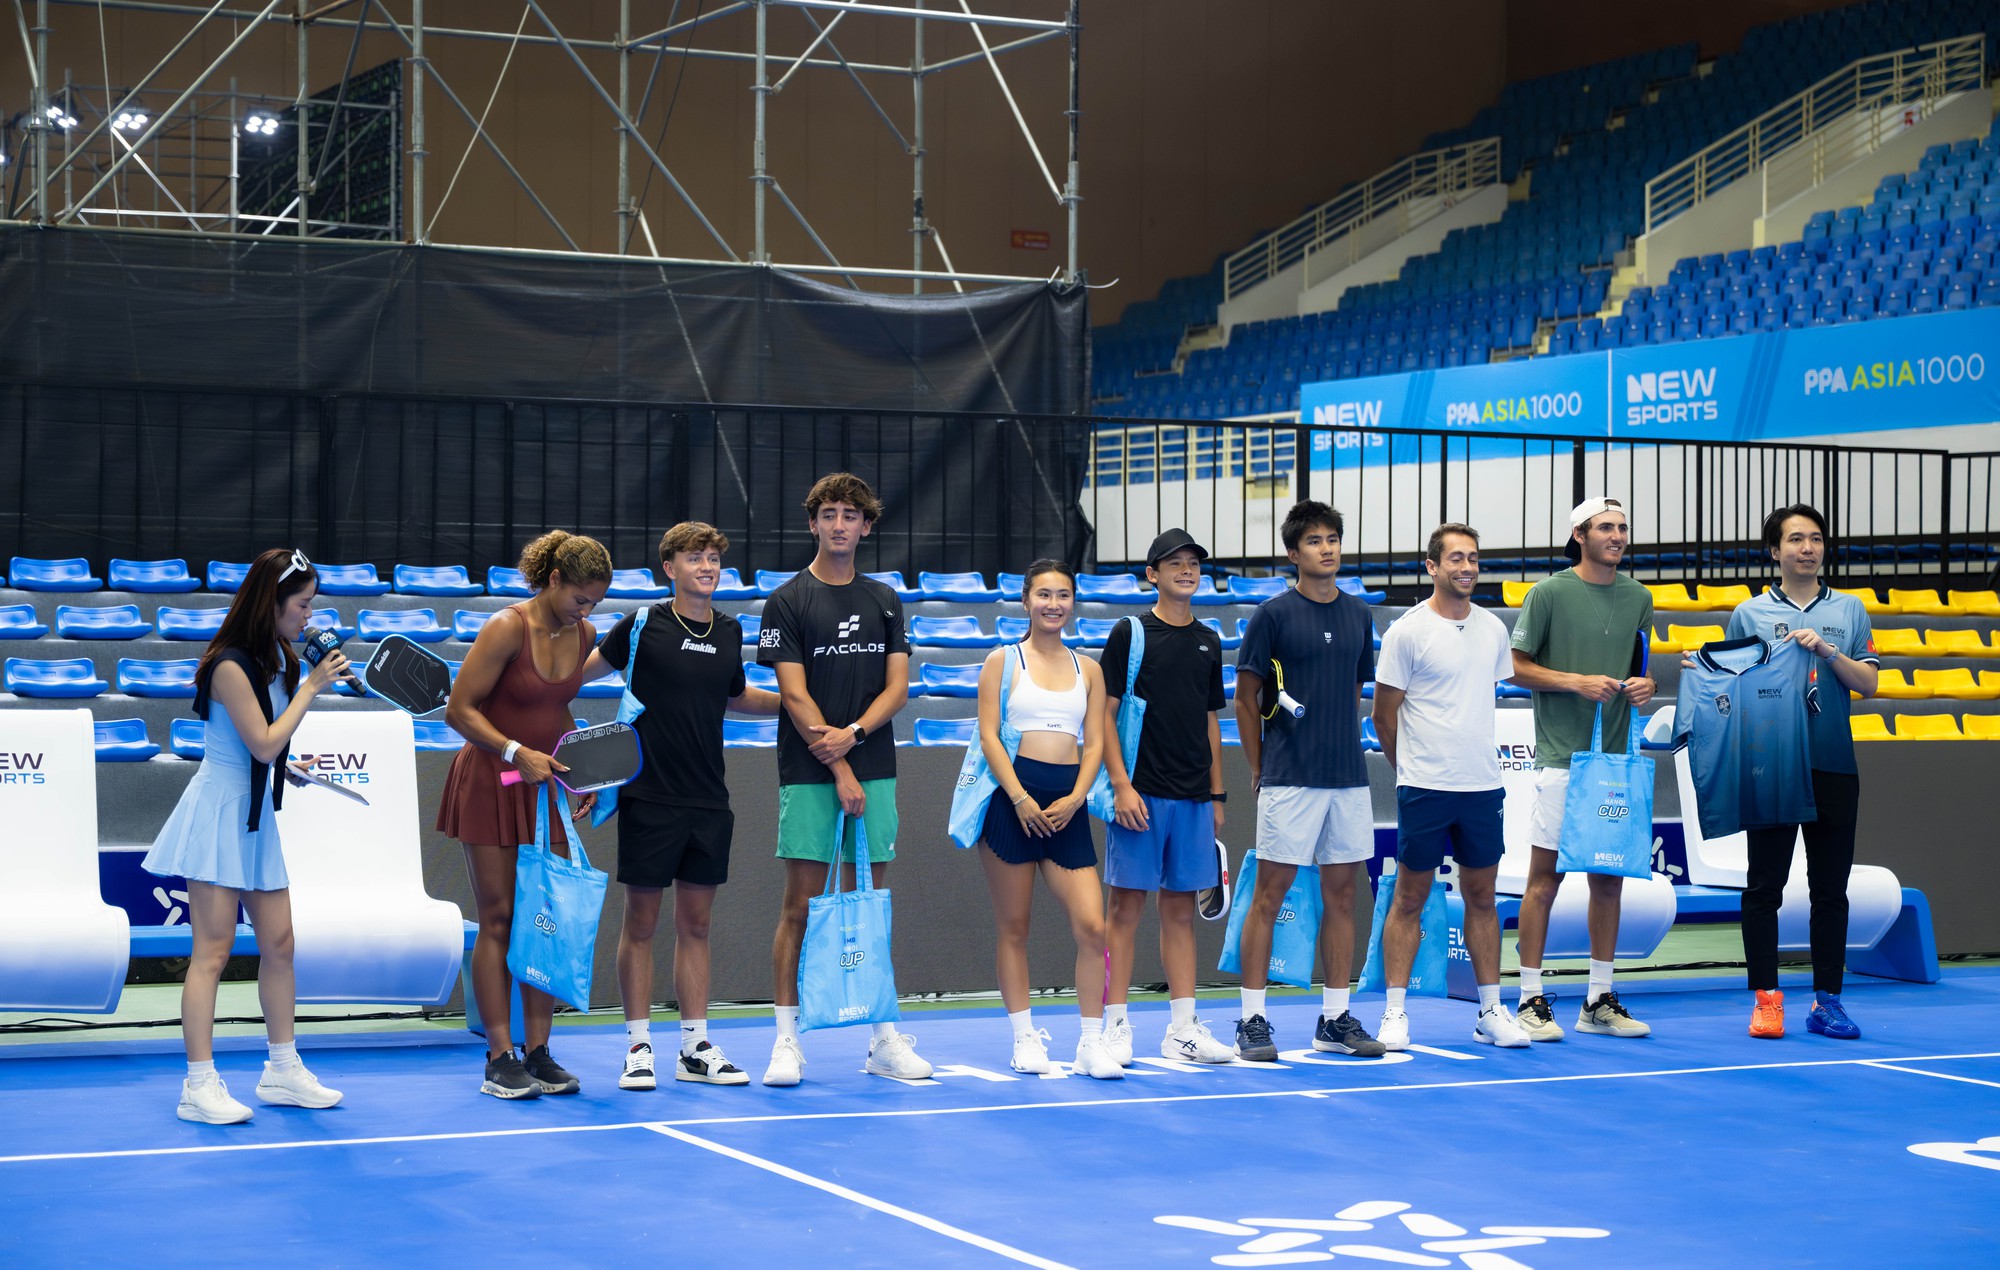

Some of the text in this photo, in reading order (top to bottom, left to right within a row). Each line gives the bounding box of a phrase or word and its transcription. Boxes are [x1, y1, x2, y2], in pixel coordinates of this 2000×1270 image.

[1626, 368, 1717, 402] NEW
[1804, 367, 1848, 395] PPA
[1314, 401, 1382, 426] NEW
[1446, 402, 1480, 427] PPA
[1627, 401, 1718, 425] SPORTS
[1314, 430, 1383, 451] SPORTS
[760, 628, 780, 639] CUR
[1822, 626, 1845, 635] NEW
[318, 632, 337, 645] PPA
[327, 640, 338, 649] ASIA
[759, 638, 780, 648] REX
[681, 639, 717, 654] Franklin
[813, 643, 885, 657] FACOLOS
[0, 752, 43, 770] EW
[0, 772, 46, 784] RTS
[1605, 798, 1626, 806] HANOI
[1598, 804, 1629, 819] CUP
[1593, 860, 1624, 868] SPORTS
[1594, 852, 1625, 862] NEW
[1276, 908, 1297, 922] UP
[534, 912, 557, 933] CUP
[840, 951, 865, 968] CUP
[1269, 957, 1286, 967] EW
[526, 965, 551, 985] NEW
[838, 1004, 870, 1017] NEW
